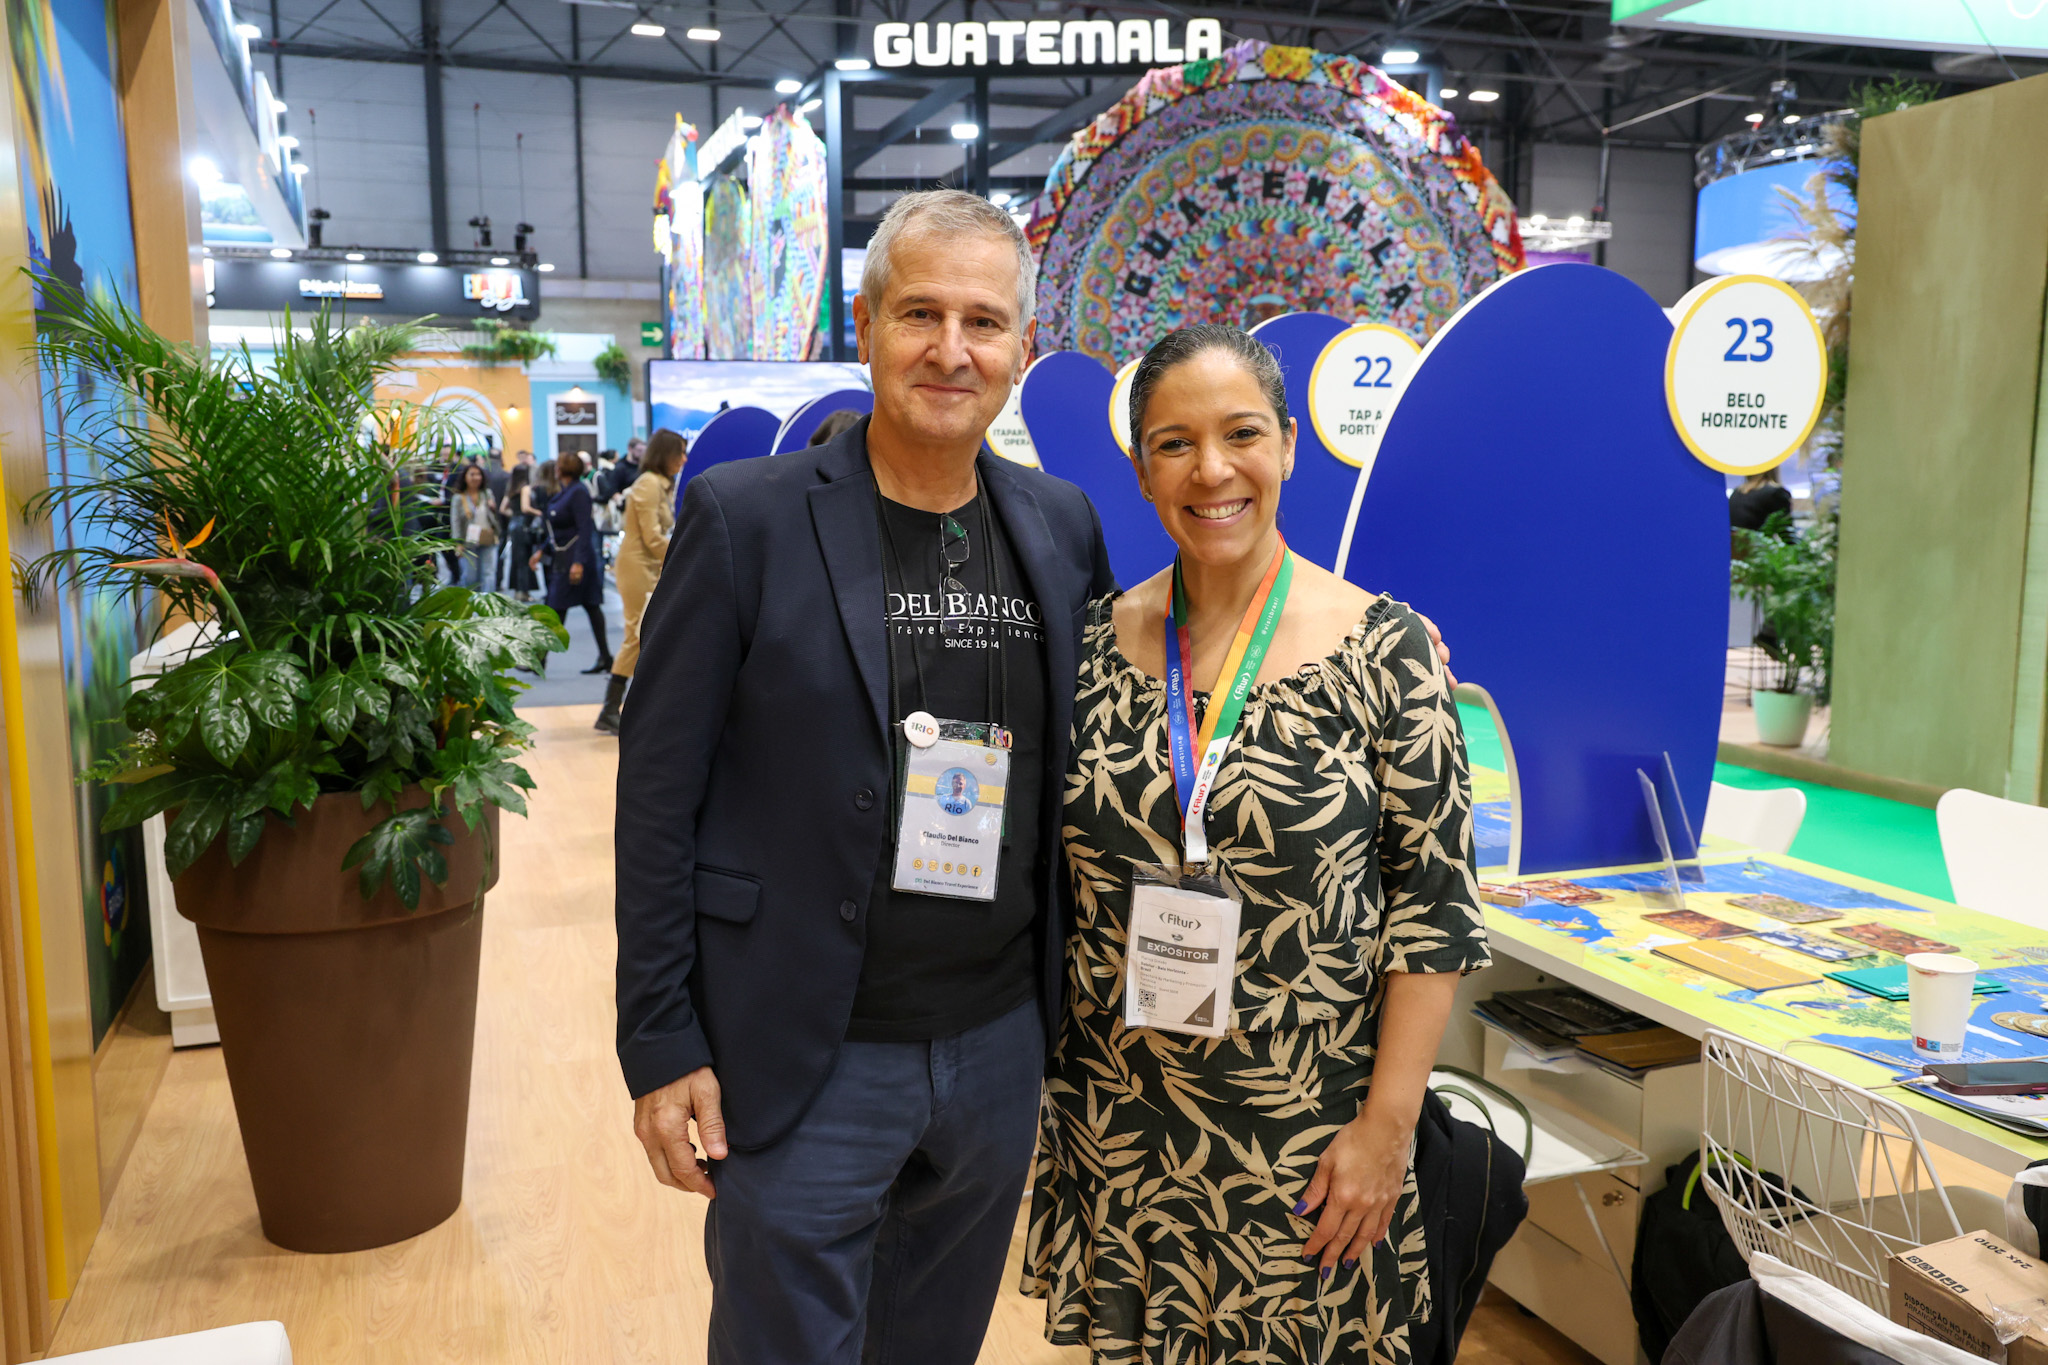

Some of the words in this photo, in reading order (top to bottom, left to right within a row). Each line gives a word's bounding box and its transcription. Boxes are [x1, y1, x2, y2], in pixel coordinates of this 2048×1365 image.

[873, 18, 1222, 67] GUATEMALA
[1723, 317, 1774, 362] 23
[1353, 355, 1393, 388] 22
[1727, 392, 1766, 408] BELO
[1349, 409, 1371, 421] TAP
[1701, 412, 1788, 429] HORIZONTE
[884, 592, 941, 617] DEL
[958, 623, 1045, 643] Expeience
[944, 638, 973, 649] SINCE
[944, 803, 963, 815] Rio
[922, 831, 946, 840] Claudio
[947, 834, 958, 842] Del
[958, 835, 980, 845] Bianco
[1146, 941, 1210, 961] EXPOSITOR
